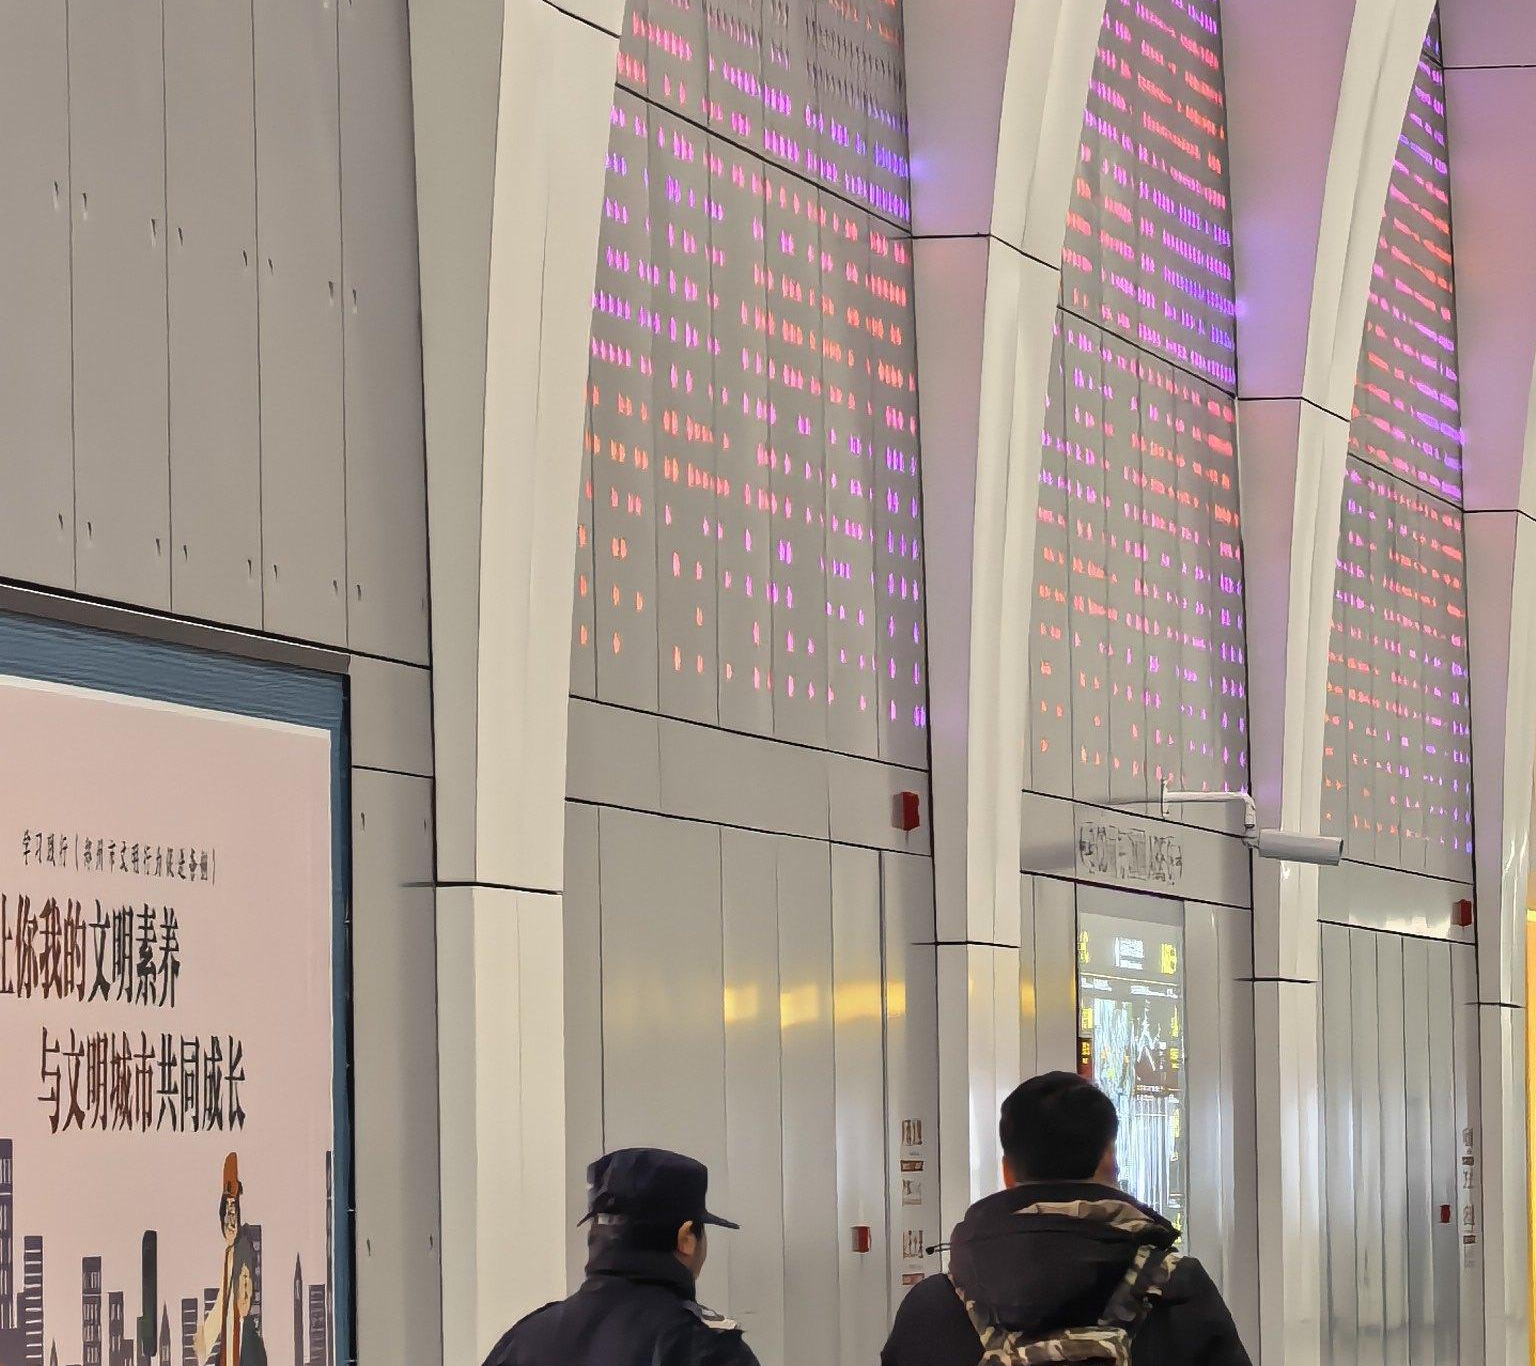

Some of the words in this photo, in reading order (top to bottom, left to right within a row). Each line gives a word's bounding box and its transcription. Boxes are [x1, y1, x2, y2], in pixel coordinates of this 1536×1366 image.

[37, 1026, 246, 1134] 与文明城市共同成长
